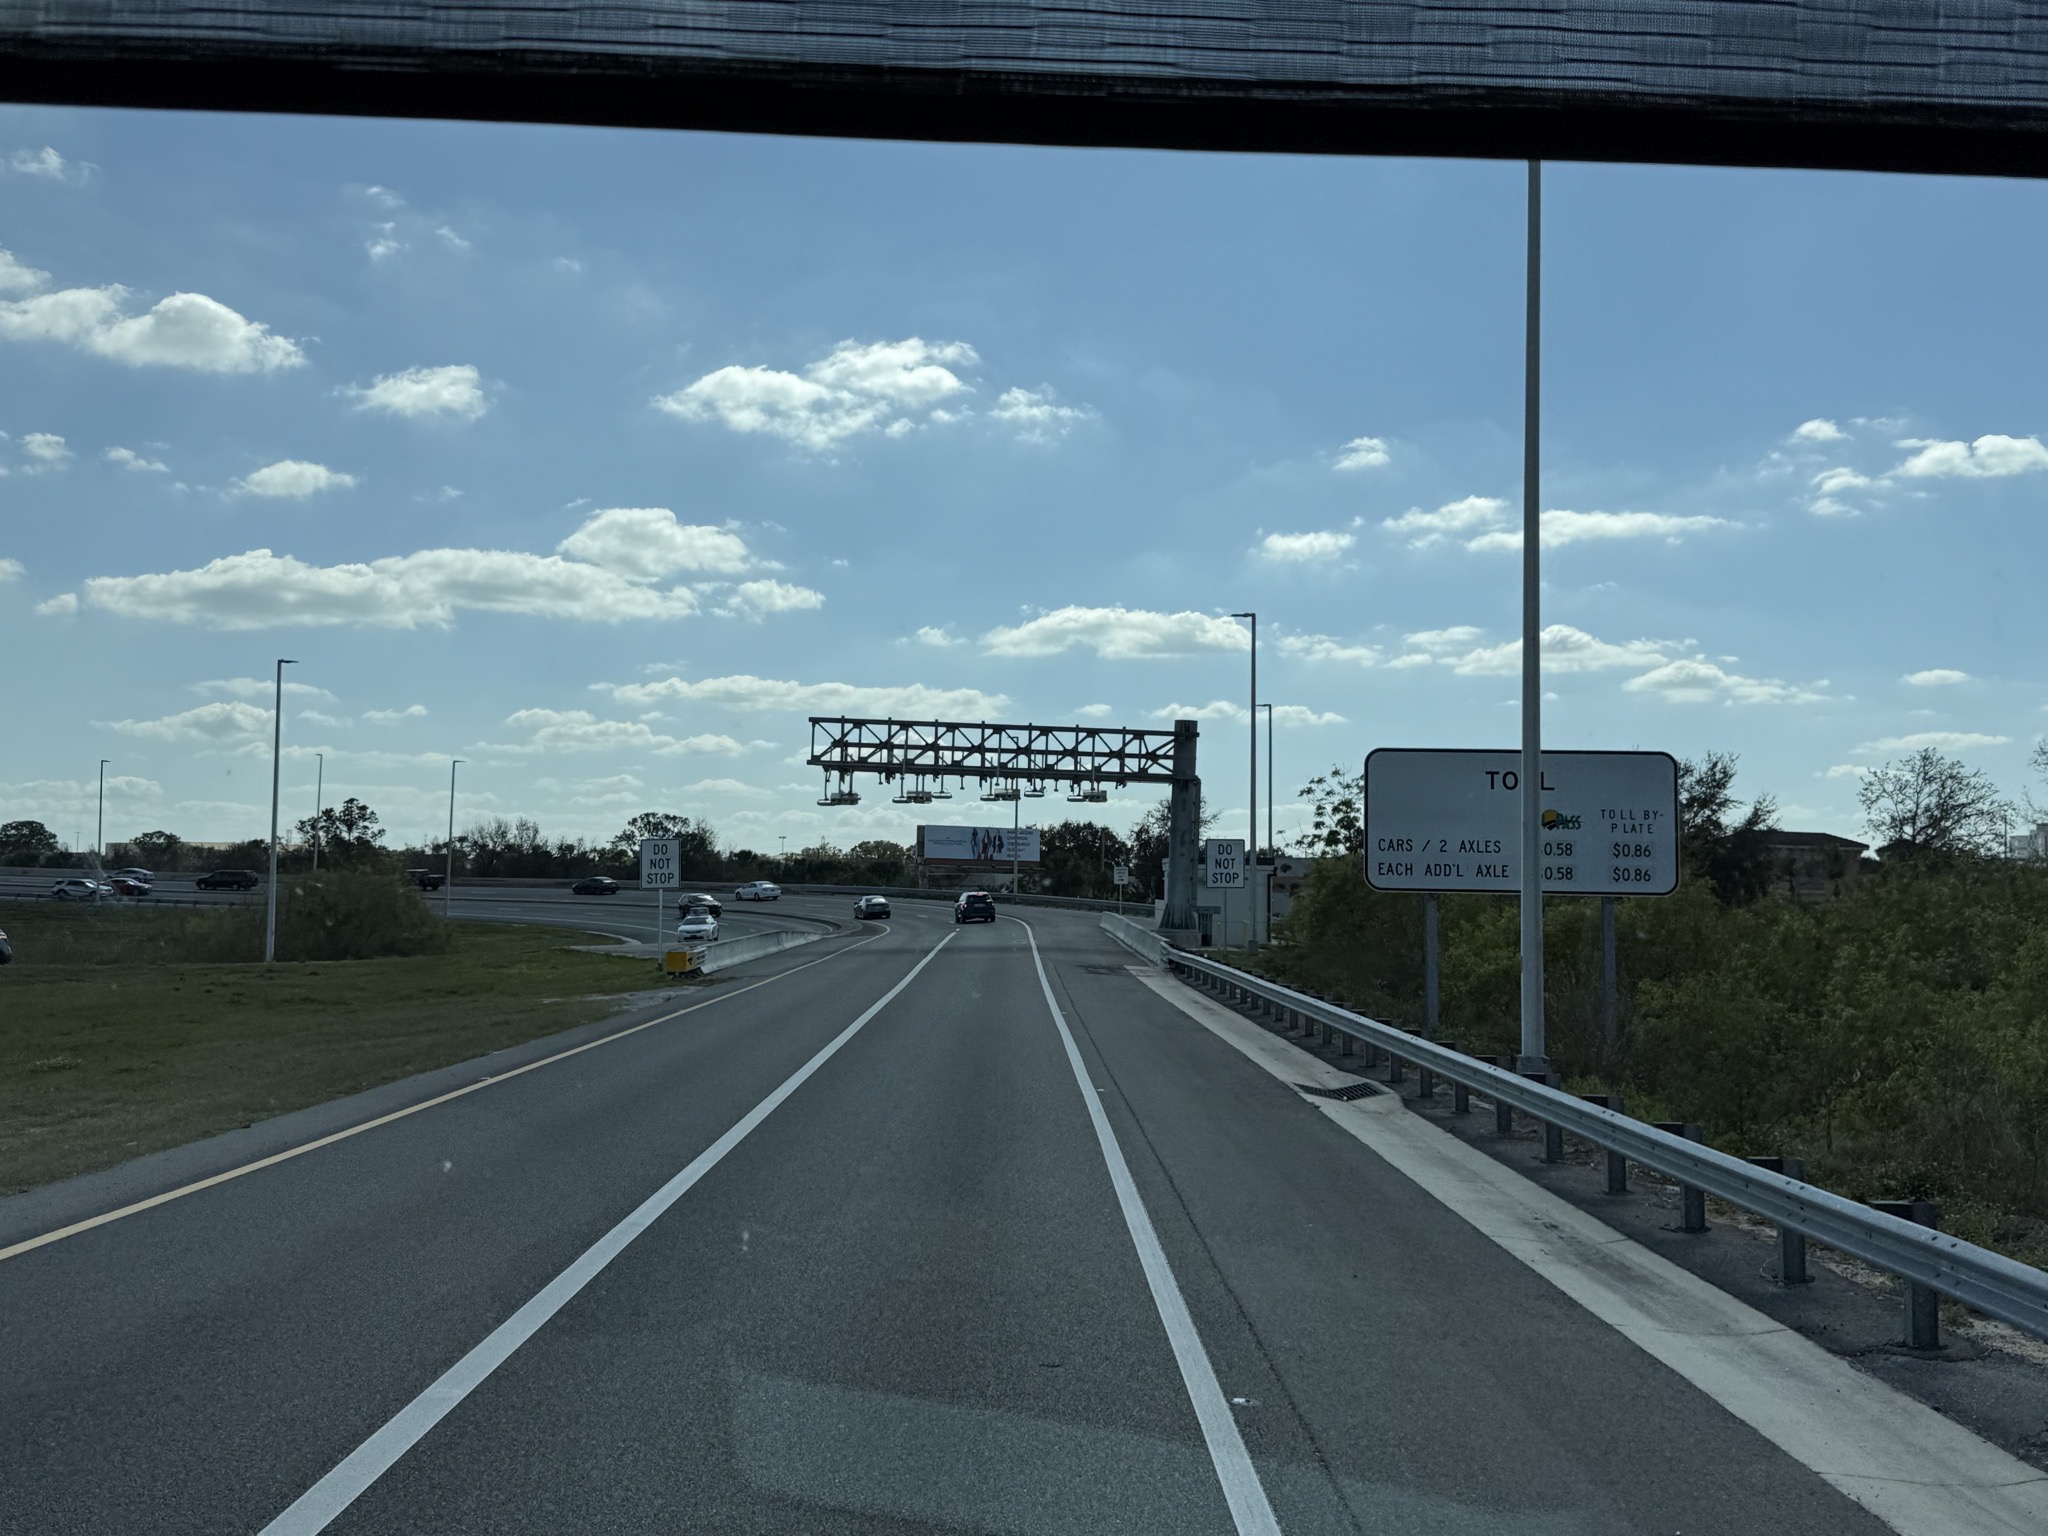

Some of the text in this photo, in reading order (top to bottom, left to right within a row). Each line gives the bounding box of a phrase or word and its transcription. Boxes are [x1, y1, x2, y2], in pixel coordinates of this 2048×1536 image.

[1485, 771, 1555, 790] TOL
[1601, 809, 1635, 820] TOLL
[1611, 823, 1654, 834] PLATE
[653, 844, 668, 855] DO
[1218, 844, 1232, 855] DO
[1378, 839, 1651, 859] CARS / 2 AXLES 0.58 $0.86
[650, 858, 671, 870] NOT
[1215, 858, 1236, 870] NOT
[647, 872, 675, 885] STOP
[1212, 872, 1239, 884] STOP
[1378, 863, 1651, 883] EACH ADD'L AXLE 0.58 $0.86
